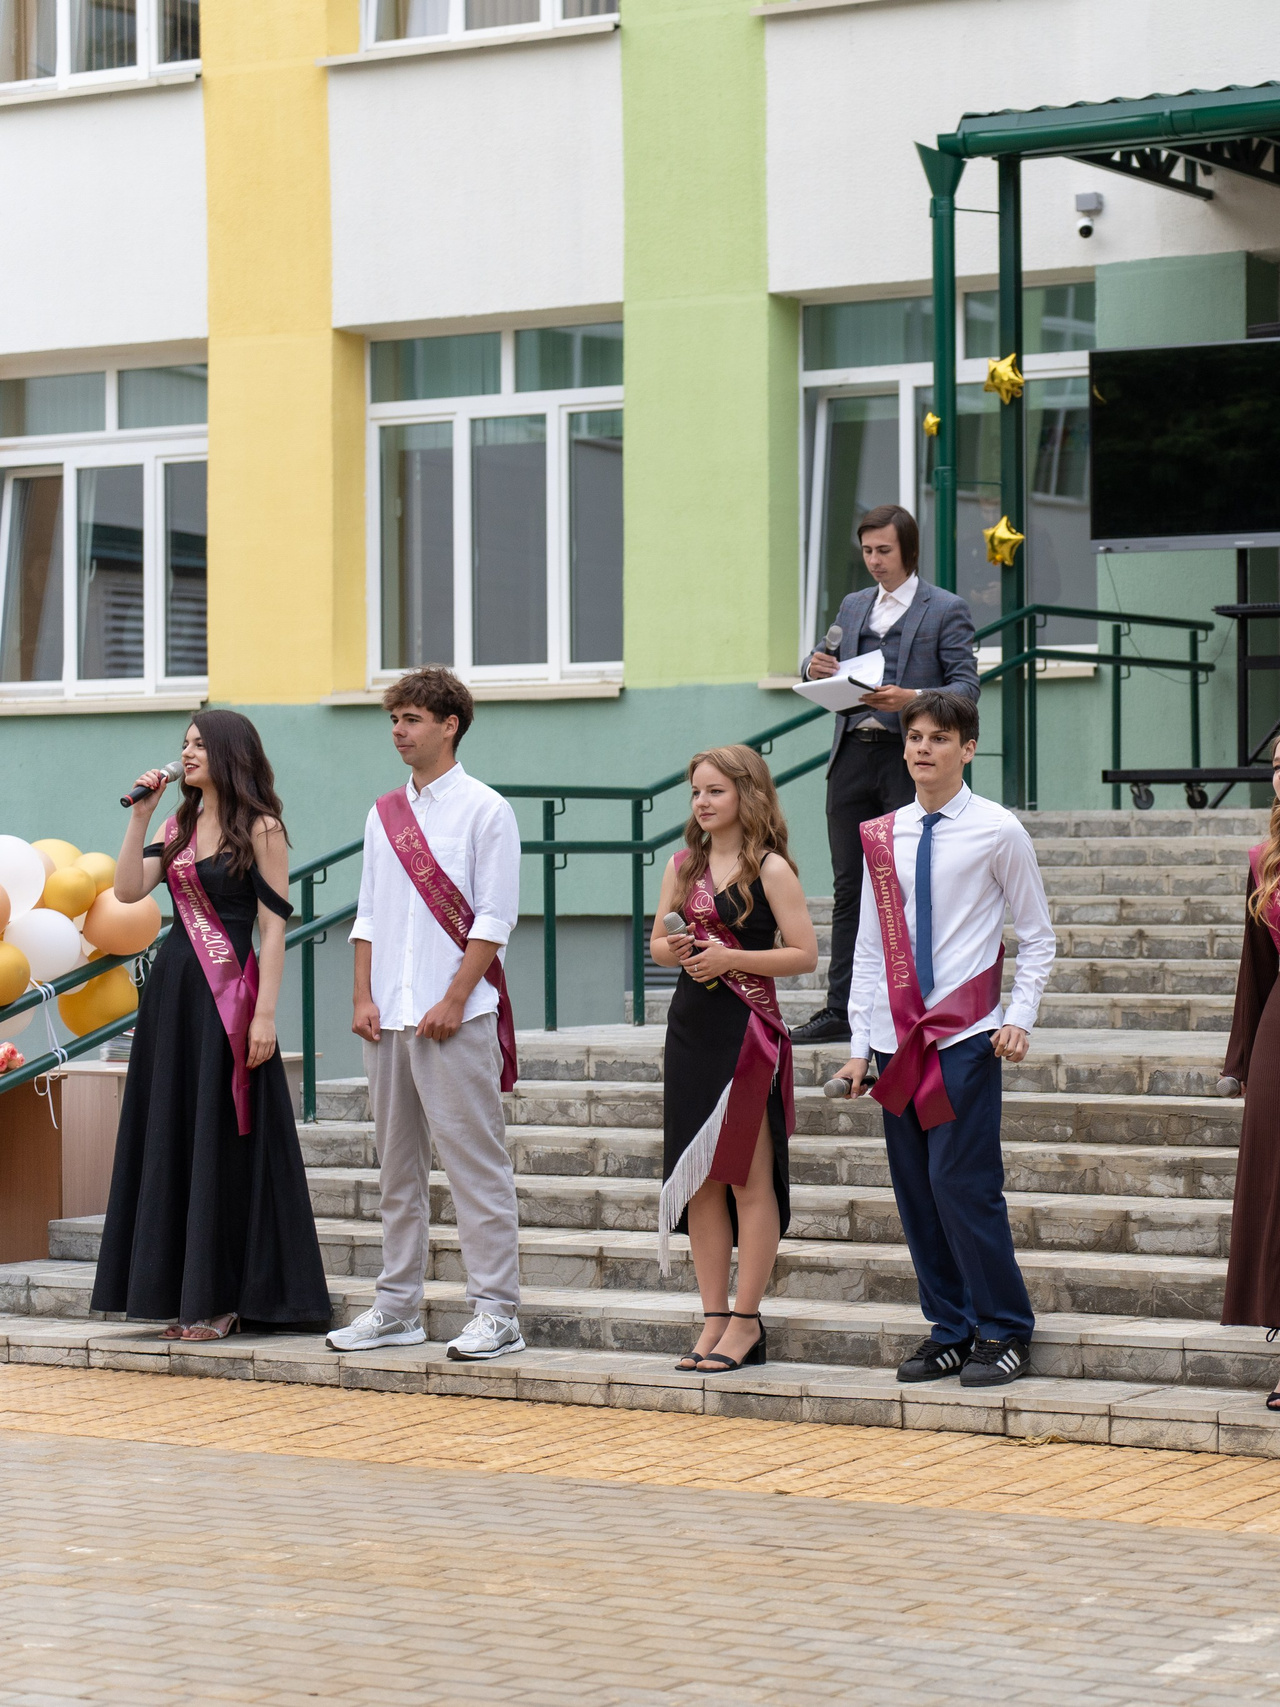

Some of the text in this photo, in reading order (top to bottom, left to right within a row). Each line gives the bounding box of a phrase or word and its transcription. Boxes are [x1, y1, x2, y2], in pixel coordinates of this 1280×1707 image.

[172, 847, 211, 935] Выпускница
[202, 932, 232, 965] 2024
[871, 844, 898, 952] Выпускник
[891, 951, 911, 990] 2024
